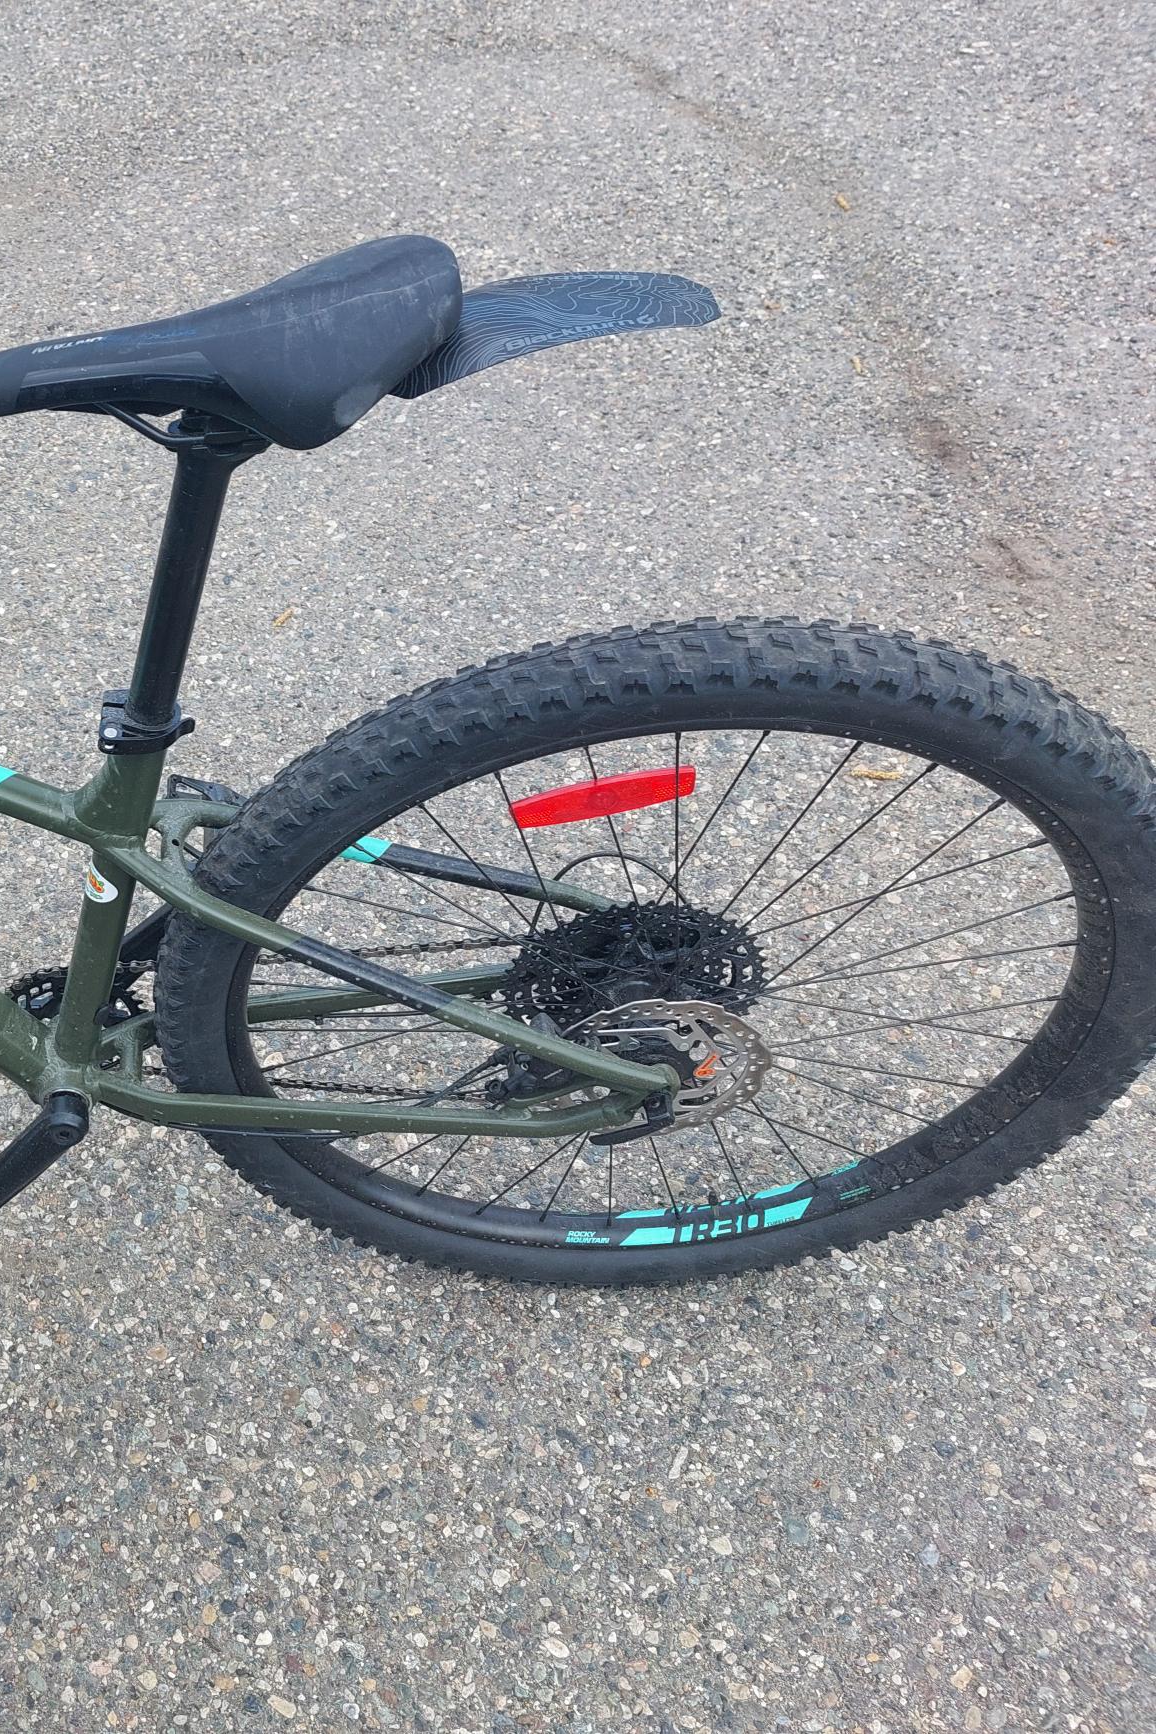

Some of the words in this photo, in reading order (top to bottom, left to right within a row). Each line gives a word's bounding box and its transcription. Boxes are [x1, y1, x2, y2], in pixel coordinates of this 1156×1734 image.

[505, 320, 634, 351] Blackburn
[567, 1230, 597, 1238] ROCKY
[668, 1212, 765, 1245] TR30
[564, 1237, 611, 1245] MOUNTAIN
